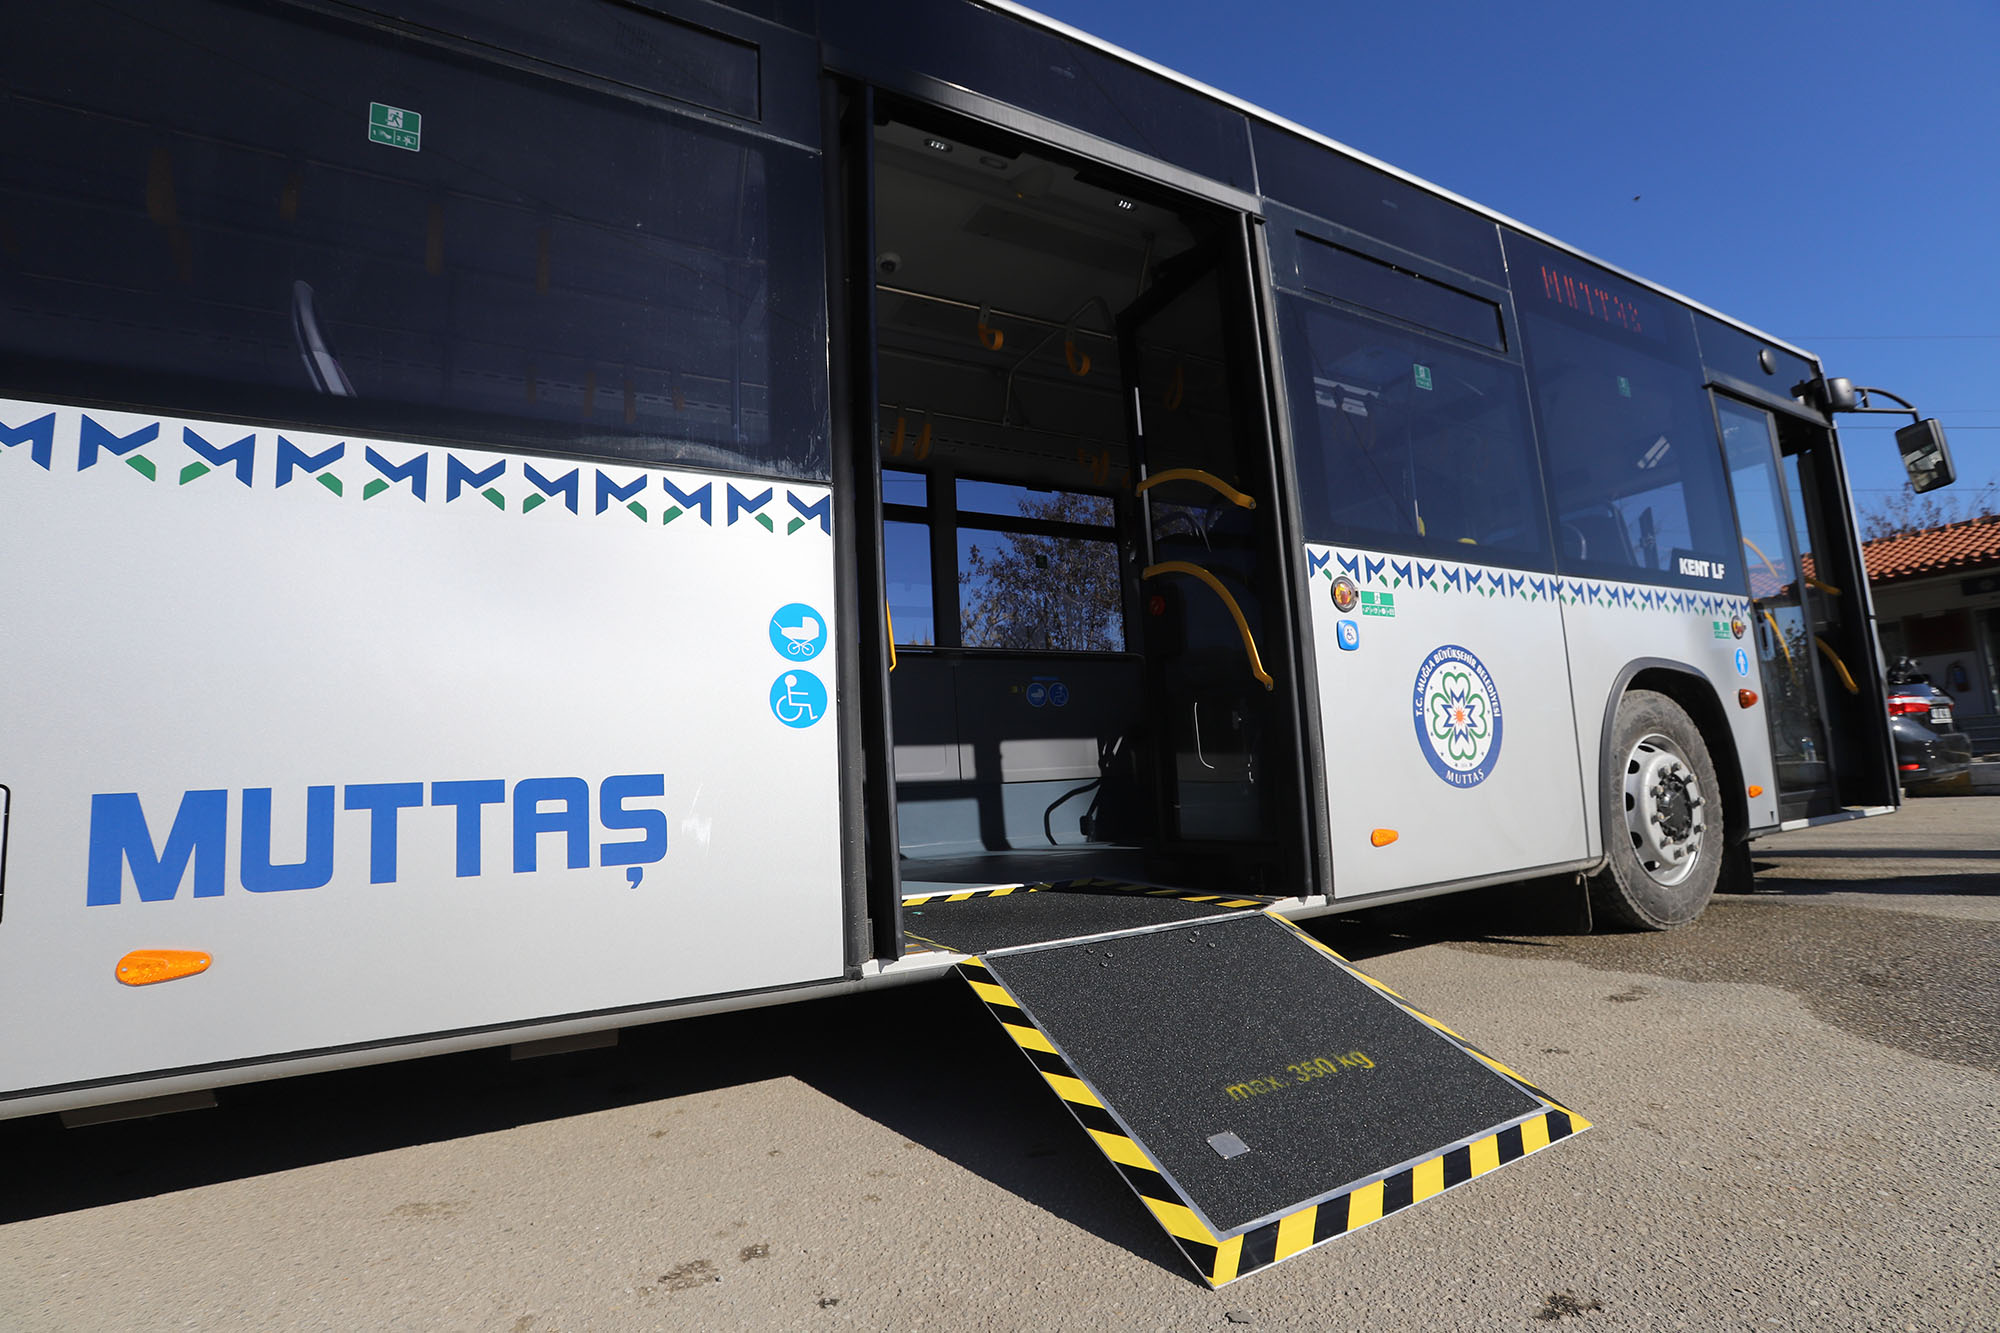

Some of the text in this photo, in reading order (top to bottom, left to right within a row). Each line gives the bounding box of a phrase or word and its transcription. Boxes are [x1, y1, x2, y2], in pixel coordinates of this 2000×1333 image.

[1679, 557, 1726, 580] KENT LF
[1417, 660, 1436, 694] MUĞLA
[1433, 647, 1477, 668] BÜYÜKŞEHİR
[86, 773, 668, 906] MUTTAŞ
[1331, 1051, 1376, 1069] kg
